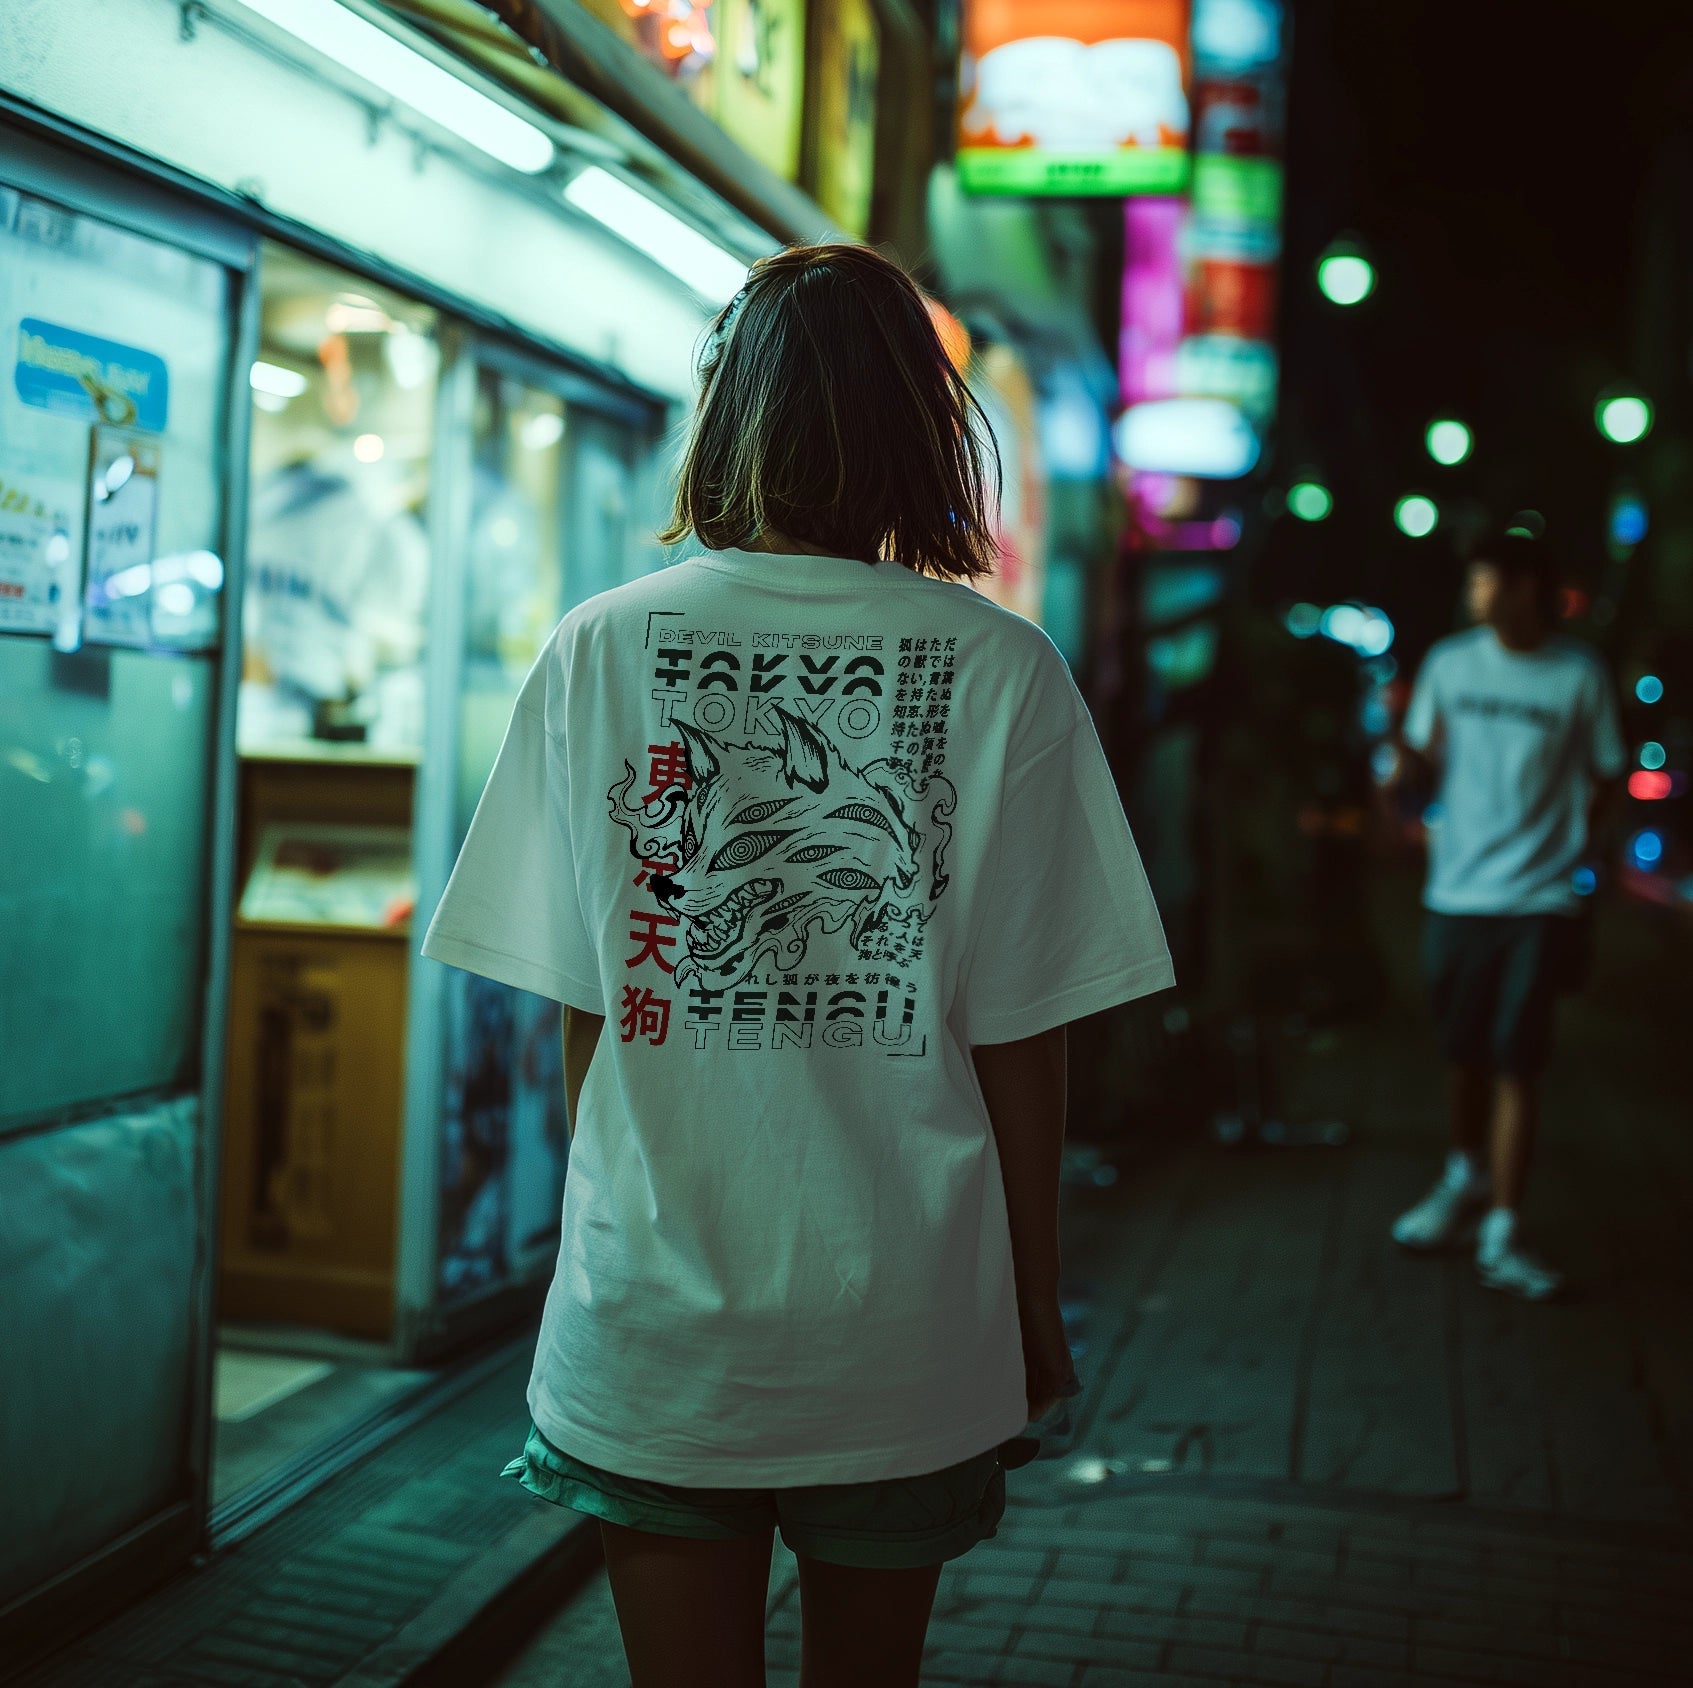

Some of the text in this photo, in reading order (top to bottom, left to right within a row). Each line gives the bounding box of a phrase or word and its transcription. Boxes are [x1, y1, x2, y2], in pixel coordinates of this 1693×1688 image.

[659, 628, 884, 651] DEVIL KITSUNE
[651, 688, 881, 740] TOKYO
[684, 1019, 912, 1051] TENGU
